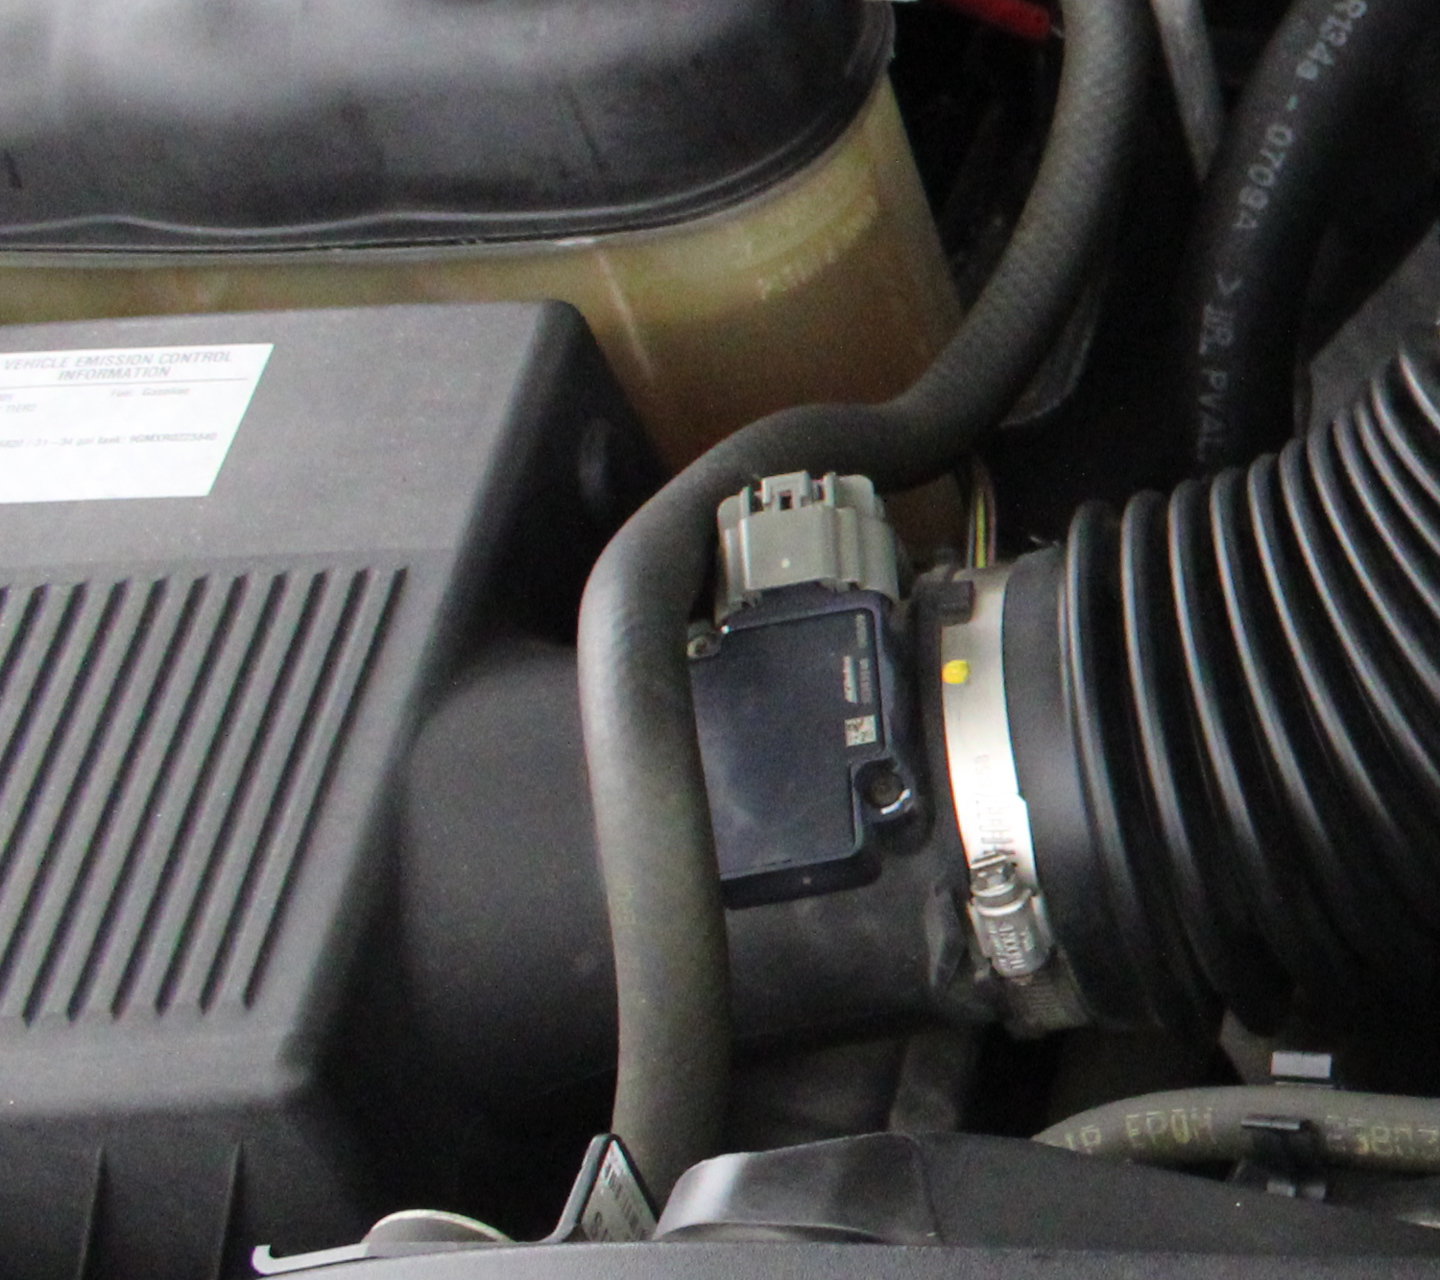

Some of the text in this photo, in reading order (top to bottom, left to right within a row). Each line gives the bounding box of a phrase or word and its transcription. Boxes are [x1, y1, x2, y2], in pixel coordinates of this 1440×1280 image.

[4, 350, 235, 371] VEHICLE EMISSION CONTROL
[57, 366, 172, 381] INFORMATION
